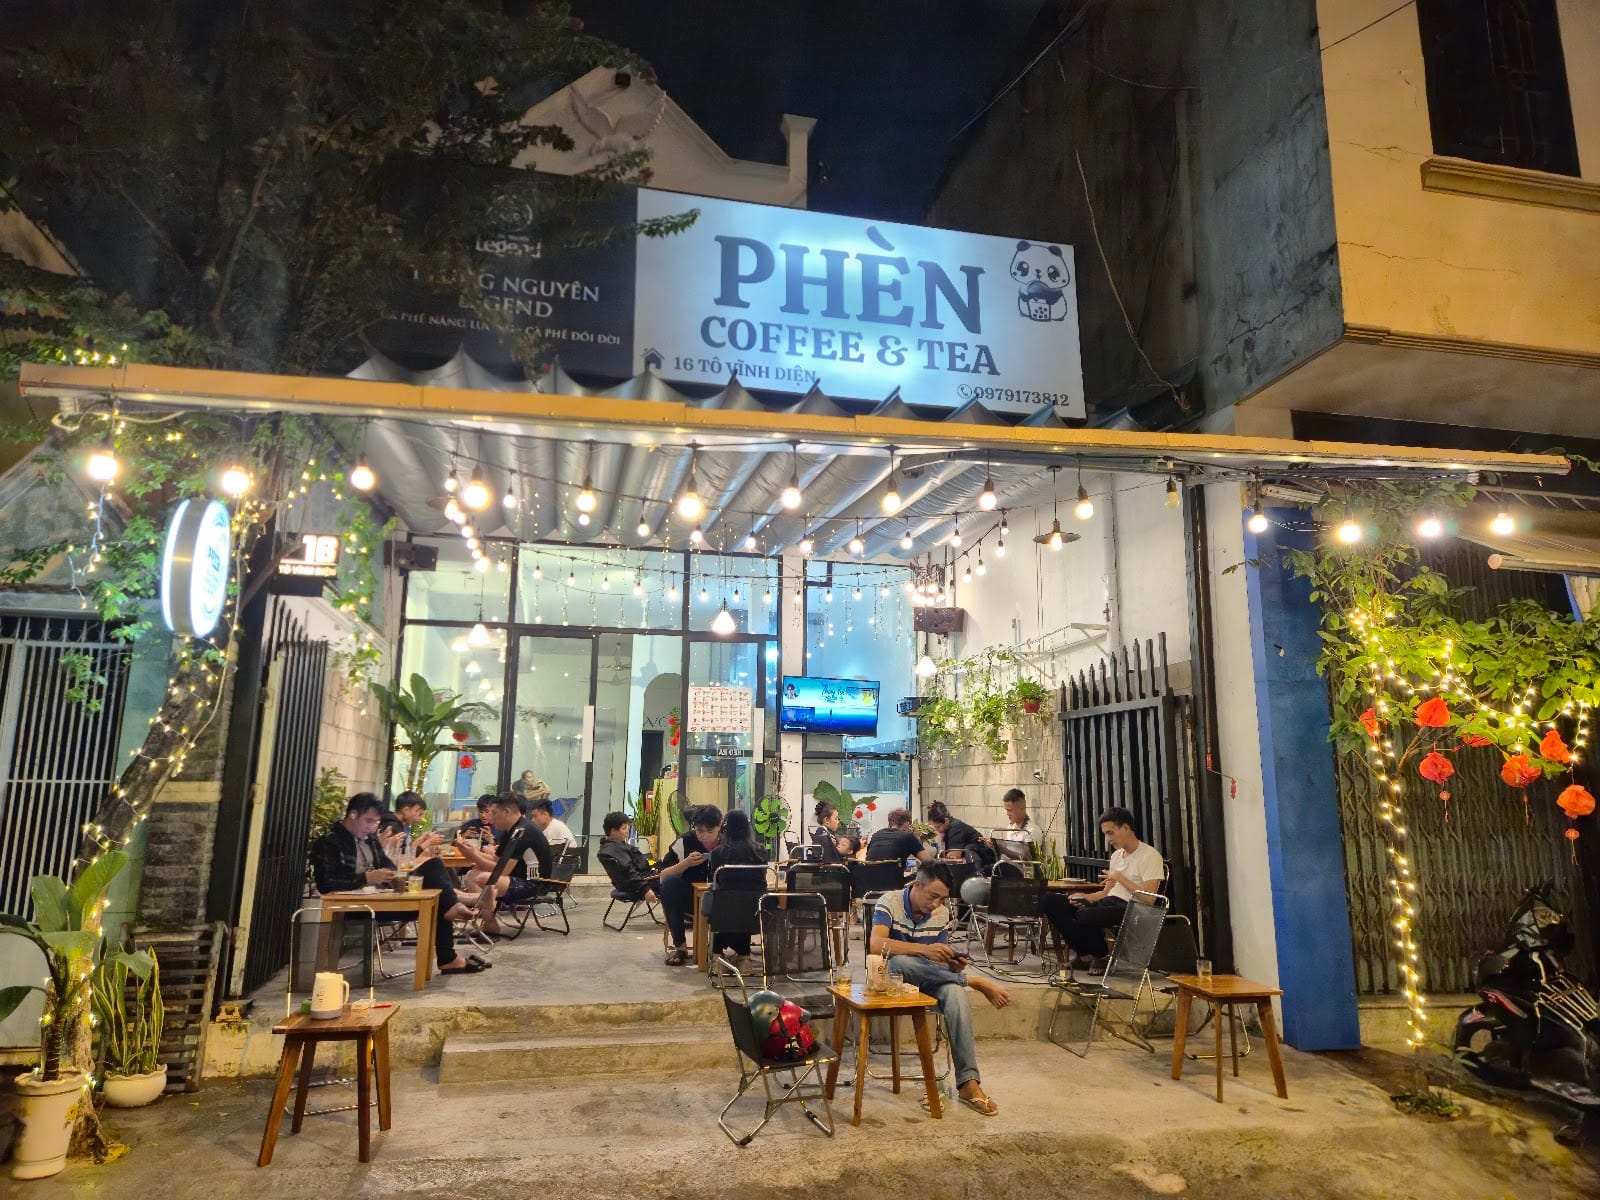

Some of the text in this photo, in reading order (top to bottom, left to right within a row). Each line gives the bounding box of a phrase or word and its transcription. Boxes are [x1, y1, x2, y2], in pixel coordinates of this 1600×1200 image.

[503, 275, 600, 303] NGUYÊN
[713, 226, 986, 334] PHÈN
[701, 316, 1001, 376] COFFEE & TEA
[674, 356, 817, 386] 16 TÔ VĨNH DIỆN
[973, 386, 1070, 406] 0979173812
